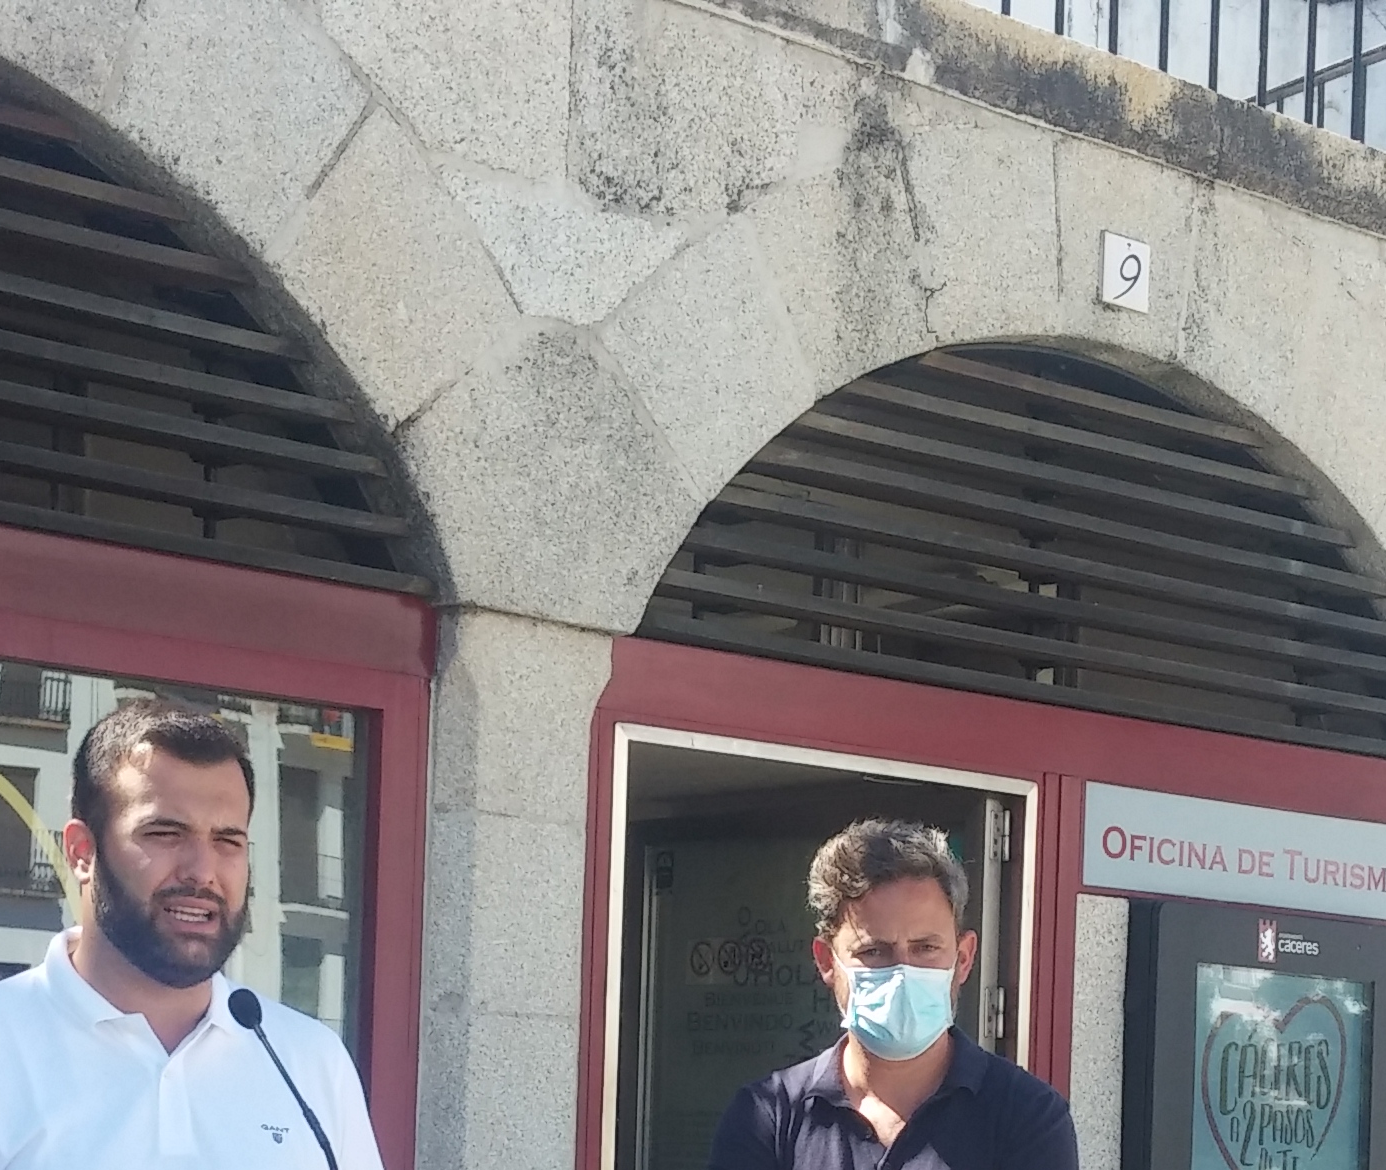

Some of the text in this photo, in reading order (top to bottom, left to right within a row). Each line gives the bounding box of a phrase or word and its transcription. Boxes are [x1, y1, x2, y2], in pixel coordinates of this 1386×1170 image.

[1113, 254, 1142, 300] 9
[1101, 824, 1230, 875] OFICINA
[1237, 848, 1275, 879] DE
[260, 1123, 290, 1133] GANT
